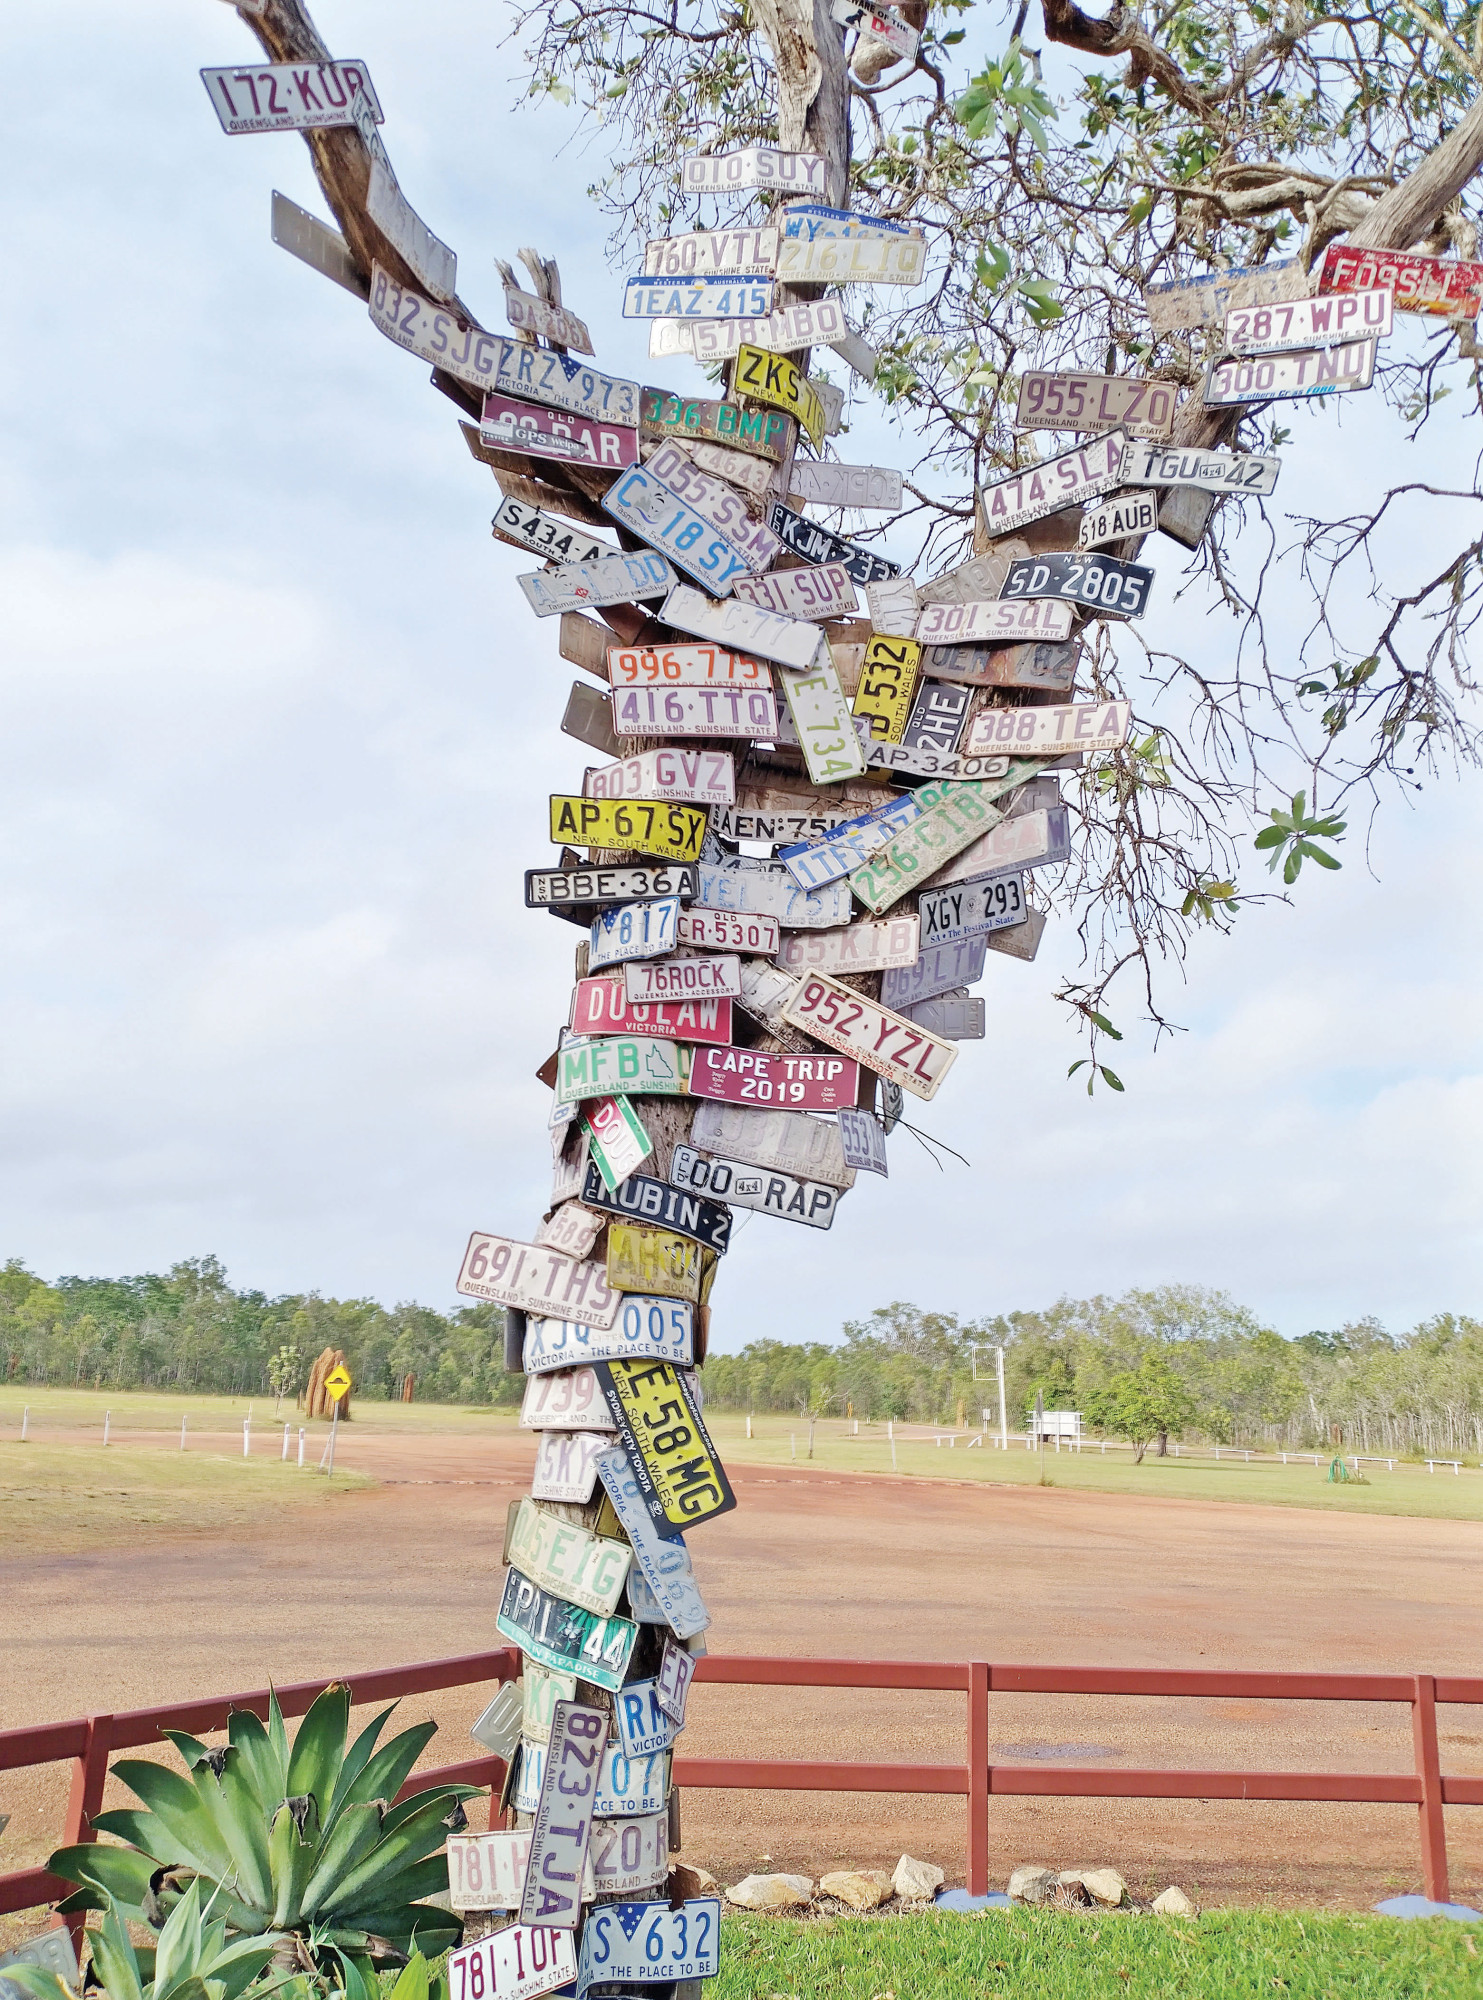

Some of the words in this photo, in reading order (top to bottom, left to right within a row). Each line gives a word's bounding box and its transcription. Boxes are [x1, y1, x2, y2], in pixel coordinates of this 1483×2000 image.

[878, 11, 889, 22] OF
[893, 20, 908, 33] THE
[230, 116, 295, 131] QUEENSLAND
[303, 111, 348, 123] SUNSHINE
[689, 180, 742, 191] QUEENSLAND
[751, 178, 790, 189] SUNSHINE
[795, 184, 818, 192] STATE
[785, 337, 813, 348] SMART
[816, 332, 841, 342] STATE
[421, 347, 460, 375] SUNSHINE
[465, 370, 490, 387] STATE
[499, 344, 556, 390] ZRZ
[581, 372, 634, 414] 973
[753, 387, 776, 400] NEW
[1306, 385, 1336, 394] FORD
[547, 411, 575, 424] QLD
[553, 393, 570, 405] THE
[575, 401, 600, 416] PLACE
[605, 411, 617, 420] TO
[623, 414, 633, 424] BE
[515, 428, 547, 444] GPS
[1022, 416, 1079, 427] QUEENSLAND
[1088, 421, 1104, 429] THE
[1140, 426, 1164, 436] STATE
[1144, 453, 1200, 479] TGU
[1223, 461, 1265, 489] 42
[615, 502, 646, 534] Tasmania
[995, 503, 1049, 528] QUEENSLAND
[1057, 481, 1100, 503] SUNSHINE
[1001, 508, 1050, 533] NISSAN
[1073, 491, 1097, 503] USED
[617, 474, 648, 507] C
[660, 511, 704, 551] 18
[699, 541, 747, 583] SY
[522, 535, 555, 556] SOUTH
[1064, 556, 1095, 564] NSW
[548, 598, 586, 611] Tasmania
[803, 605, 834, 617] SUNSHINE
[836, 601, 855, 611] STATE
[923, 631, 976, 641] QUEENSLAND
[1033, 629, 1060, 638] STATE
[890, 702, 906, 741] SOUTH
[898, 658, 917, 700] WALES
[624, 725, 684, 733] QUEENSLAND
[695, 725, 740, 733] SUNSHINE
[745, 725, 770, 735] STATE
[912, 707, 925, 729] QLD
[974, 743, 1031, 753] QUEENSLAND
[1041, 741, 1087, 750] SUNSHINE
[1091, 739, 1117, 747] STATE
[651, 789, 695, 799] SUNSHINE
[701, 791, 728, 800] STATE
[573, 834, 599, 845] NEW
[608, 838, 649, 851] SOUTH
[656, 844, 687, 861] WALES
[714, 912, 737, 922] QLD
[926, 893, 963, 935] XGY
[982, 881, 1021, 918] 293
[620, 906, 671, 944] 817
[931, 935, 941, 944] SA
[948, 930, 962, 939] The
[963, 920, 993, 934] Festival
[996, 915, 1015, 928] State
[598, 953, 611, 961] THE
[615, 946, 639, 959] PLACE
[641, 964, 726, 992] 76ROCK
[625, 1022, 677, 1035] VICTORIA
[565, 1043, 640, 1089] MFB
[707, 1049, 771, 1078] CAPE
[784, 1060, 844, 1080] TRIP
[804, 1024, 859, 1060] TOOWOOMBA
[861, 1055, 894, 1079] TOYOTA
[565, 1079, 629, 1098] QUEENSLAND
[640, 1081, 684, 1090] SUNSHINE
[740, 1078, 805, 1103] 2019
[677, 1153, 690, 1183] QLD
[738, 1180, 759, 1193] 4x4
[765, 1178, 832, 1217] RAP
[464, 1282, 518, 1303] QUEENSLAND
[528, 1297, 572, 1317] SUNSHINE
[577, 1309, 604, 1324] STATE
[623, 1305, 685, 1346] 005
[531, 1350, 574, 1369] VICTORIA
[591, 1347, 611, 1356] THE
[618, 1344, 650, 1354] PLACE
[655, 1344, 668, 1354] TO
[673, 1349, 684, 1358] BE
[606, 1389, 624, 1429] SYDNEY
[622, 1429, 636, 1451] CITY
[631, 1453, 652, 1493] TOYOTA
[612, 1370, 632, 1399] NEW
[627, 1408, 652, 1455] SOUTH
[649, 1460, 674, 1509] WALES
[600, 1461, 627, 1513] VICTORIA
[631, 1527, 645, 1551] THE
[642, 1555, 662, 1591] PLACE
[662, 1596, 674, 1611] TO
[673, 1617, 683, 1630] BE
[583, 1622, 629, 1671] 44
[541, 1651, 600, 1680] PARADISE
[546, 1710, 566, 1792] QUEENSLAND
[538, 1805, 551, 1868] SUNSHINE
[524, 1873, 537, 1915] STATE
[645, 1911, 710, 1963] 632
[610, 1966, 632, 1977] THE
[638, 1965, 675, 1977] PLACE
[680, 1963, 693, 1974] TO
[699, 1961, 712, 1972] BE
